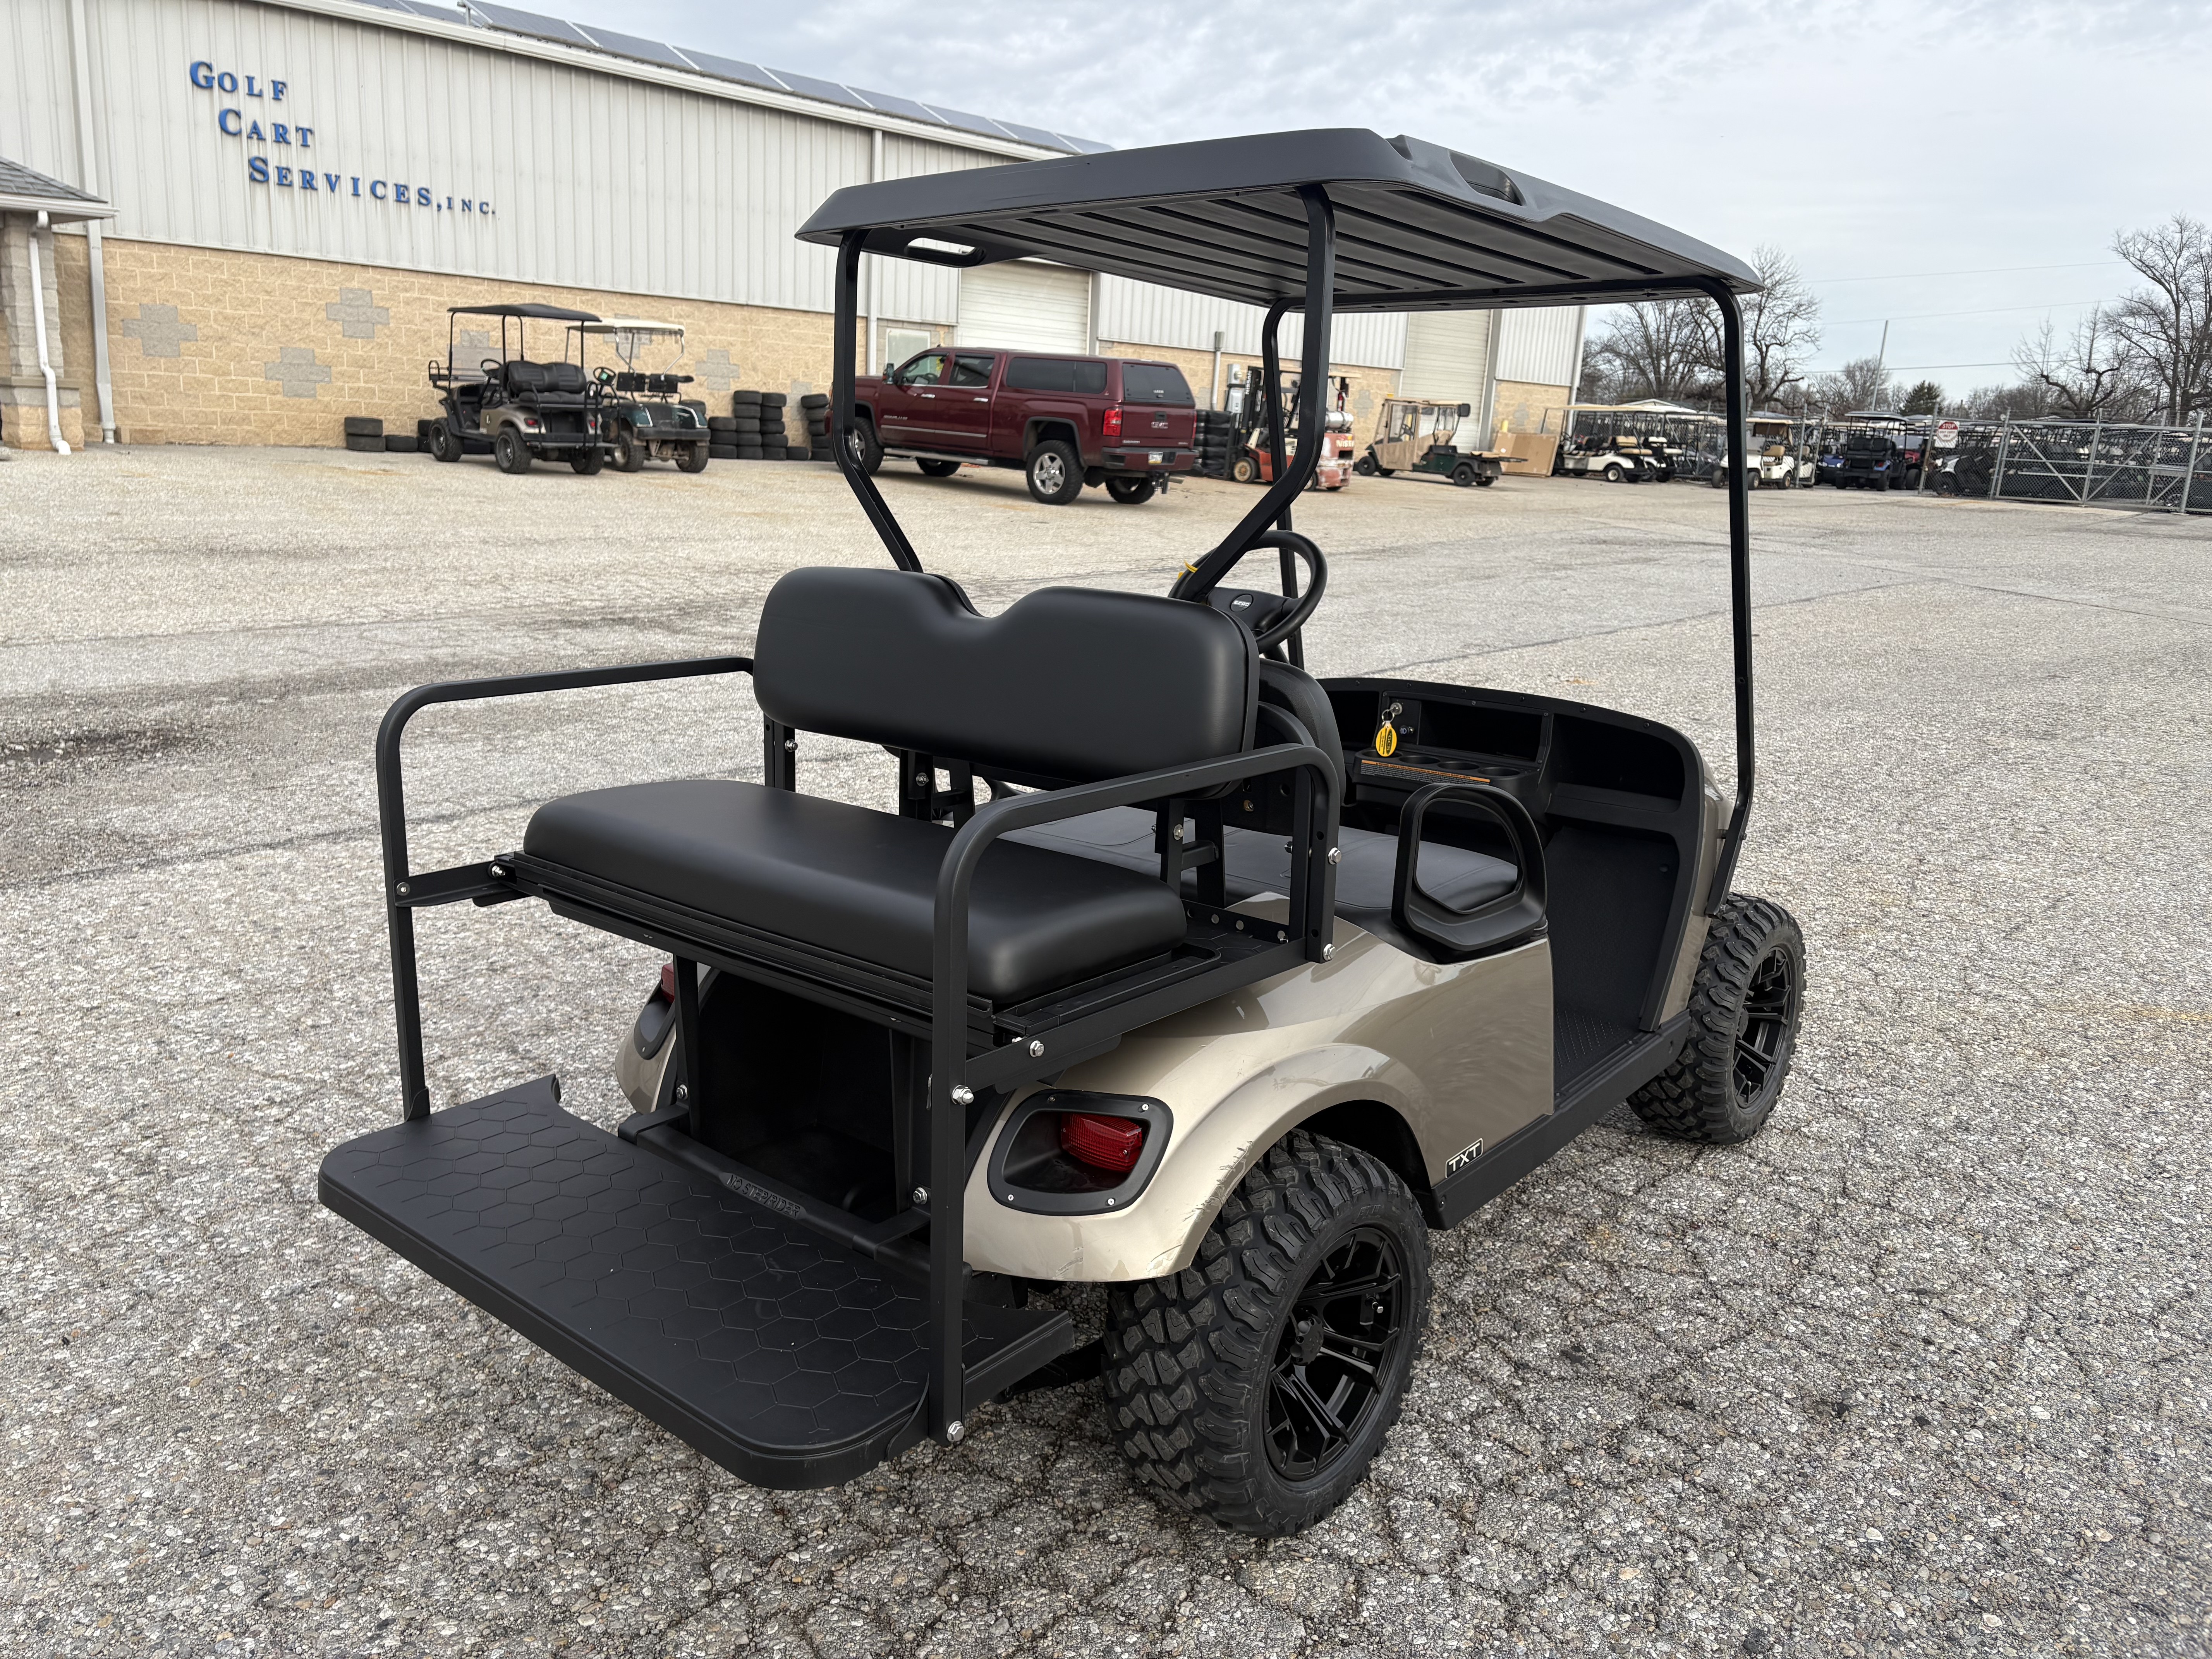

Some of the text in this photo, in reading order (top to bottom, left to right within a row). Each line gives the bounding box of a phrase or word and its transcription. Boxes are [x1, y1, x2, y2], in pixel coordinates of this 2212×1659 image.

[190, 60, 287, 100] GOLF
[218, 108, 313, 147] CART
[1449, 1142, 1480, 1171] TXT
[726, 1175, 743, 1190] NO
